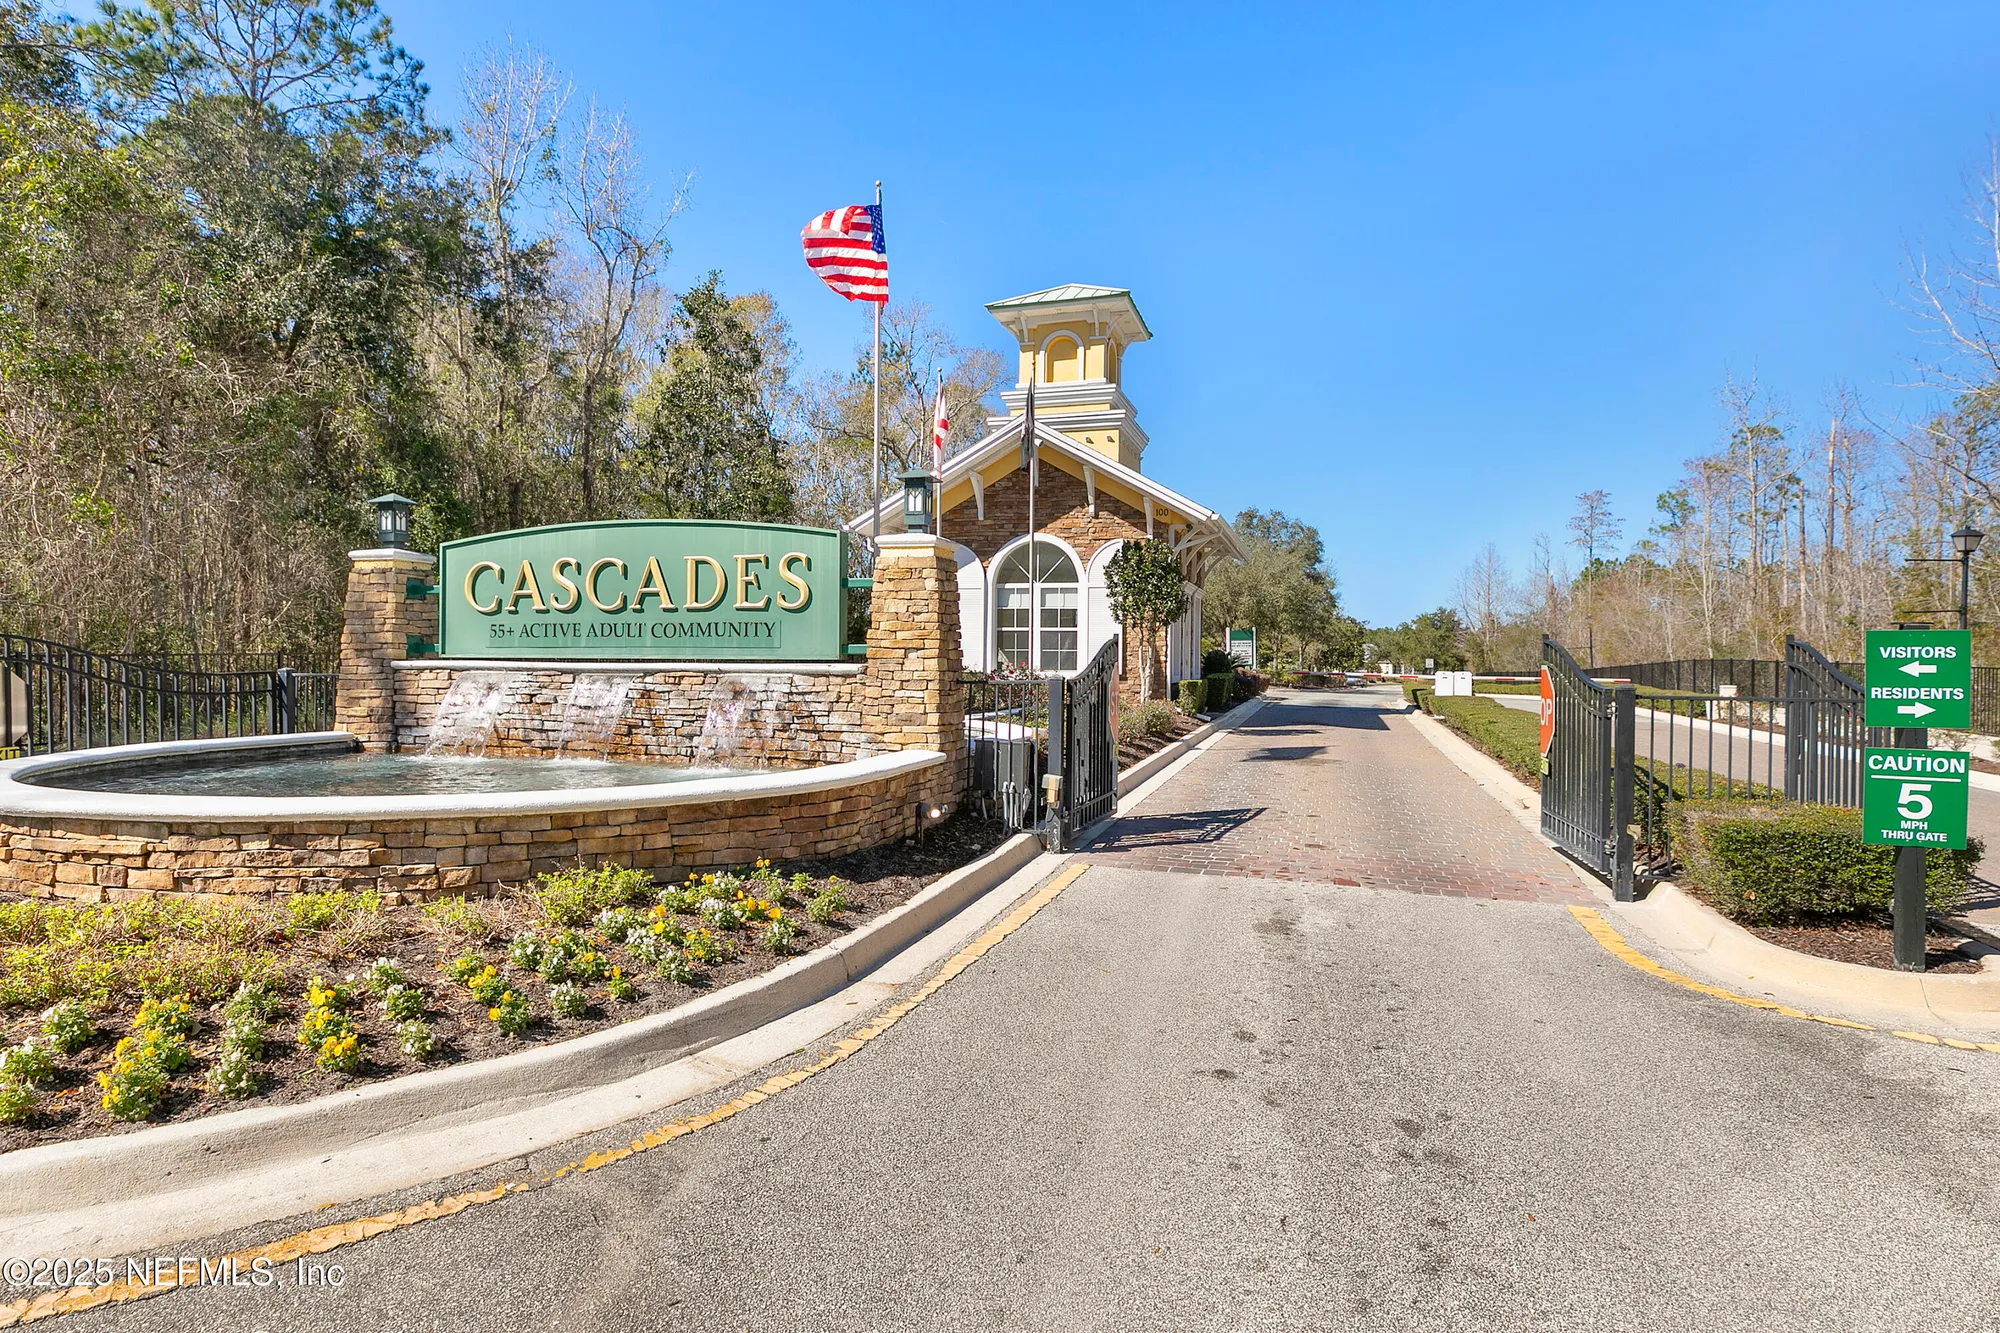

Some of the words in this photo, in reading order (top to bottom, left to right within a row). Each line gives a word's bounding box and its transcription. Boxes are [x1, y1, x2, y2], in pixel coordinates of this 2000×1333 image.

[463, 551, 813, 613] CASCADES
[489, 623, 515, 639] 55+
[519, 622, 582, 638] ACTIVE
[586, 622, 647, 638] ADULT
[650, 620, 777, 639] COMMUNITY
[1879, 646, 1957, 659] VISITORS
[1870, 687, 1965, 700] RESIDENTS
[1868, 754, 1966, 774] CAUTION
[1896, 783, 1933, 820] 5
[1900, 820, 1928, 831] MPH
[1881, 829, 1914, 841] THRU
[1917, 831, 1948, 843] GATE
